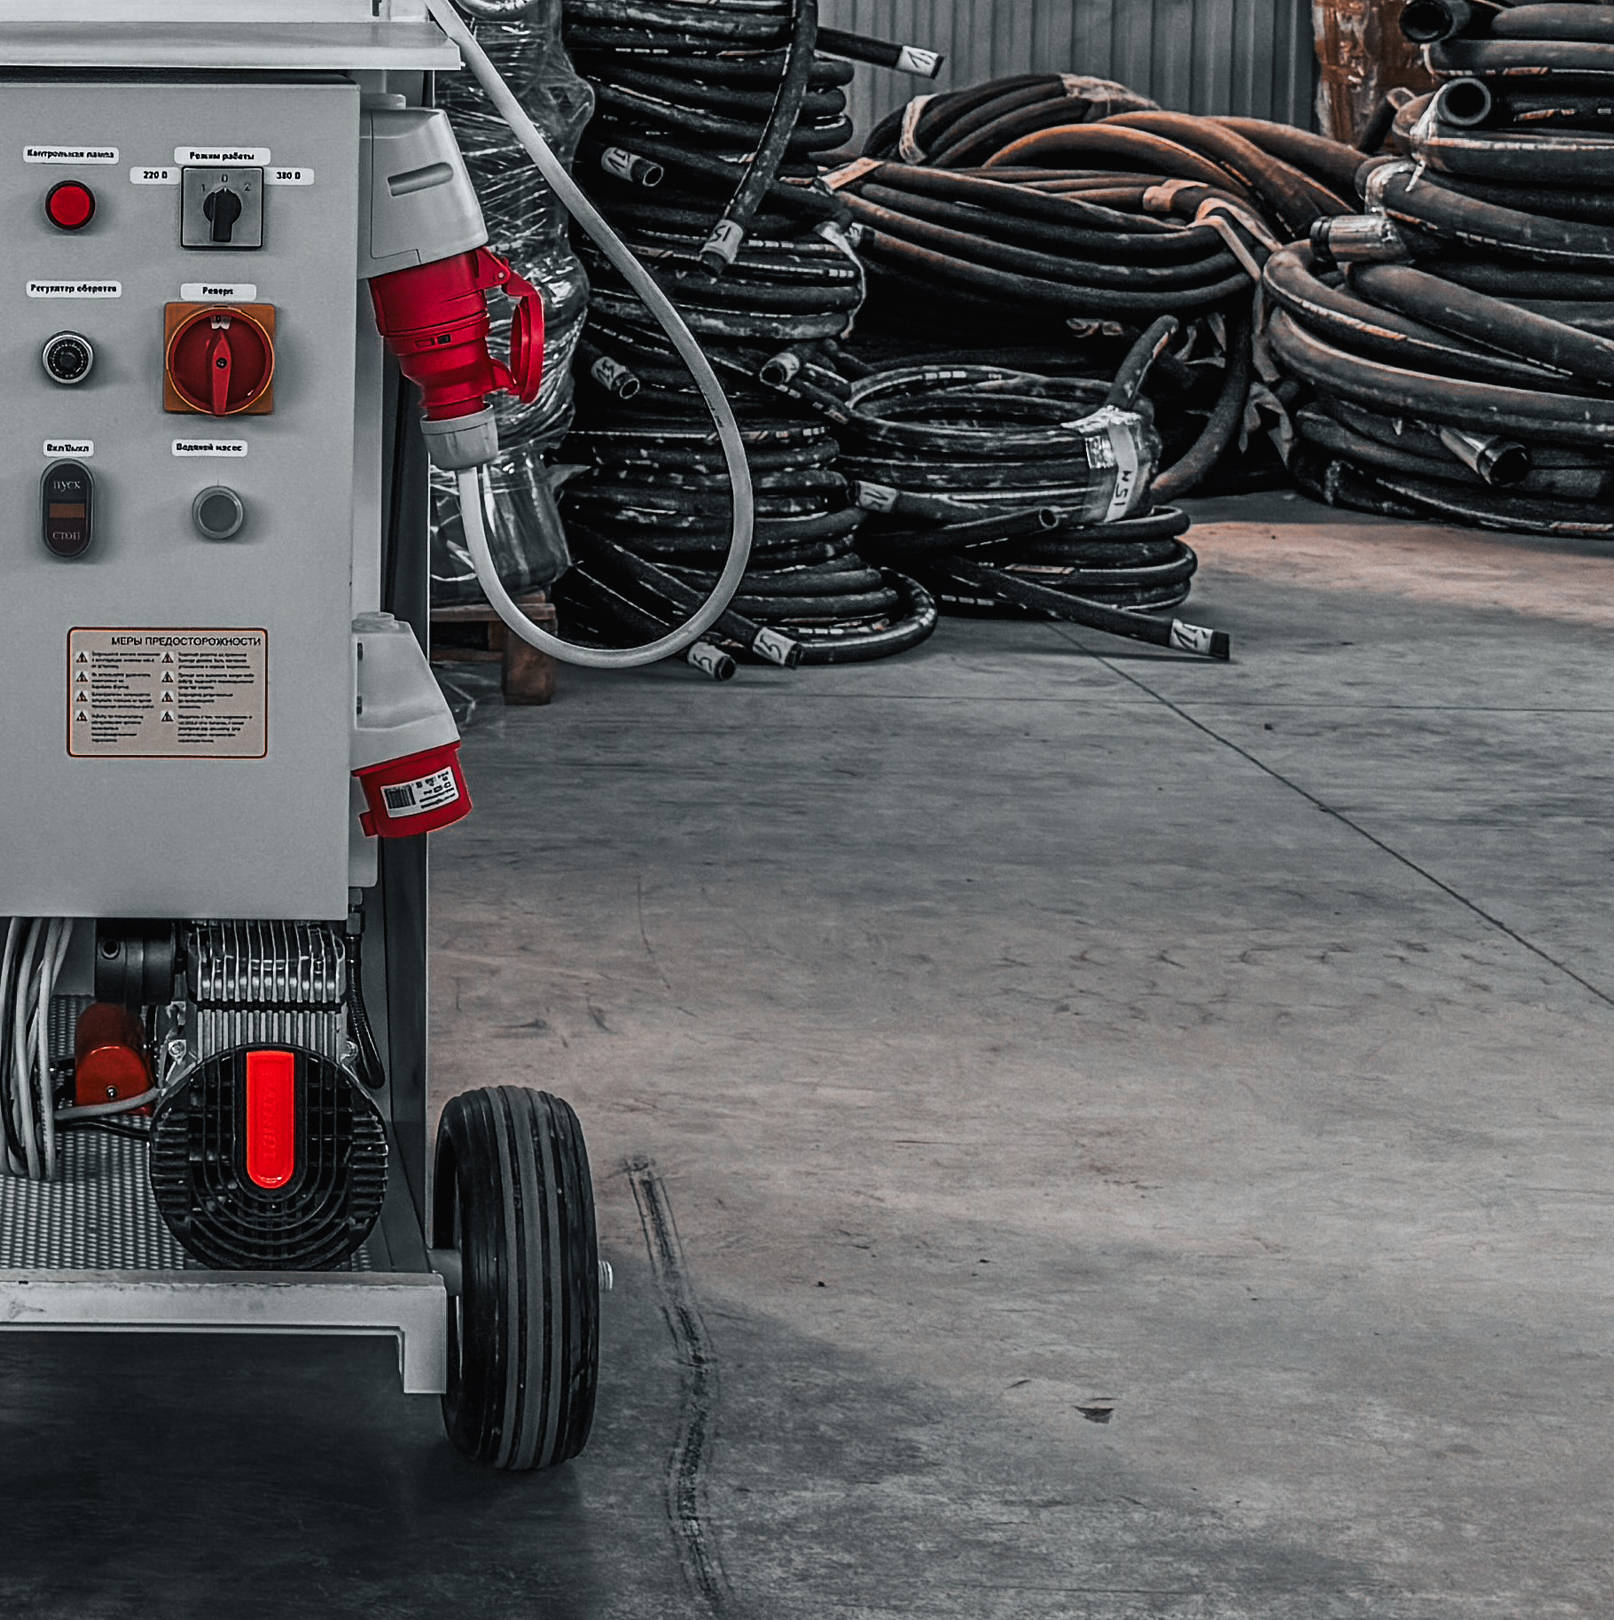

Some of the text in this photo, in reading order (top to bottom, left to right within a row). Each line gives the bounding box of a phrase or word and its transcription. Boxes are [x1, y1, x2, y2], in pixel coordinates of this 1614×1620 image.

[142, 171, 160, 180] 220
[221, 174, 228, 183] 0
[276, 171, 293, 180] 380
[200, 183, 206, 192] 1
[244, 183, 252, 192] 2
[53, 481, 81, 492] ПУСК
[52, 531, 81, 541] СТОП
[111, 636, 262, 648] МЕРЫ ПРЕДОСТОРОЖНОСТИ
